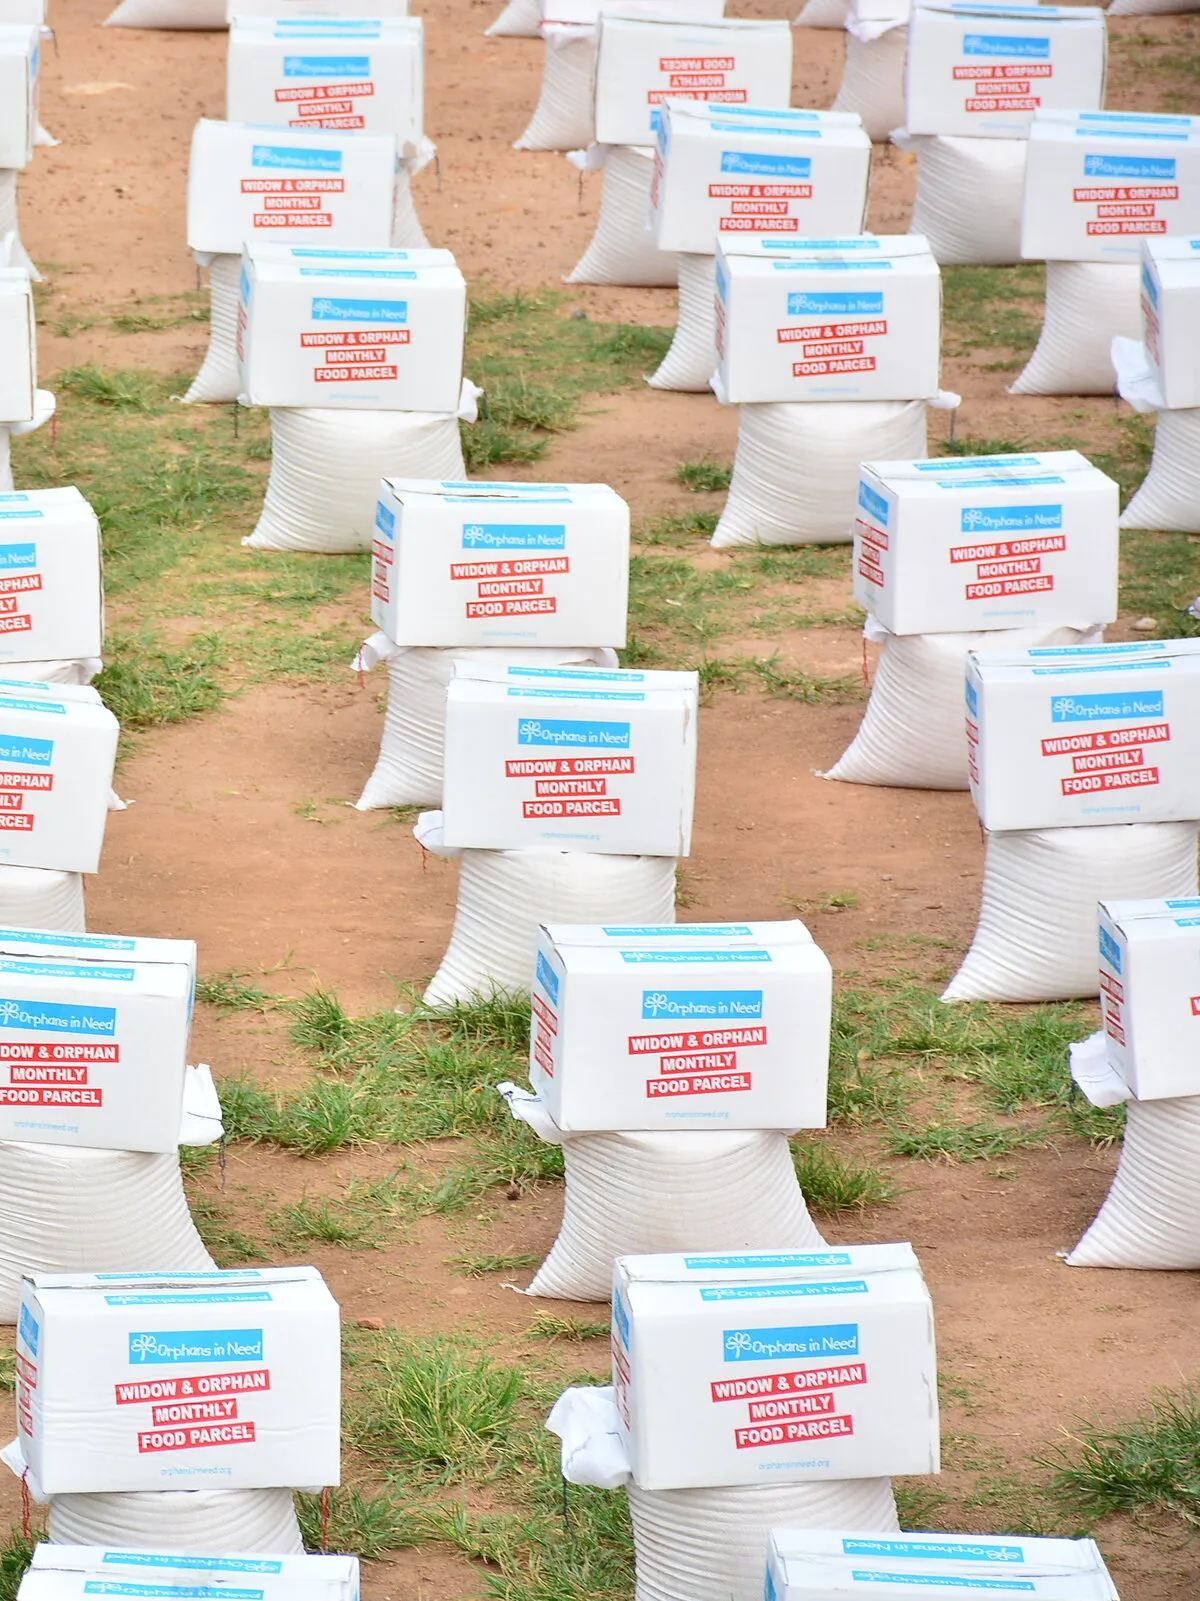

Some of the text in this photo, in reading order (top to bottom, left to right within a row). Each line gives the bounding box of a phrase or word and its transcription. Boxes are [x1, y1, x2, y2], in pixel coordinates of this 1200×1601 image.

[1075, 189, 1116, 200] WIDOW
[1129, 187, 1176, 199] ORPHAN
[779, 327, 822, 341] WIDOW
[835, 322, 885, 337] ORPHAN
[804, 341, 862, 357] MONTHLY
[794, 358, 875, 375] FOOD PARCEL
[1043, 725, 1168, 753] WIDOW & ORPHAN
[508, 758, 632, 775] WIDOW & ORPHAN
[1074, 750, 1141, 771] MONTHLY
[537, 780, 605, 795] MONTHLY
[1063, 769, 1158, 793] FOOD PARCEL
[524, 800, 619, 815] FOOD PARCEL
[667, 1001, 762, 1017] Orphans in Need
[18, 1012, 115, 1031] Orphans in Need
[631, 1028, 764, 1052] WIDOW & ORPHAN
[37, 1046, 50, 1059] &
[53, 1046, 116, 1060] ORPHAN
[662, 1053, 735, 1072] MONTHLY
[12, 1068, 86, 1082] MONTHLY
[648, 1074, 749, 1095] FOOD PARCEL
[42, 1090, 100, 1104] PARCEL
[157, 1341, 262, 1361] Orphans in Need
[751, 1336, 857, 1357] Orphans in Need
[118, 1372, 267, 1401] WIDOW & ORPHAN
[714, 1366, 863, 1399] WIDOW & ORPHAN
[154, 1401, 235, 1423] MONTHLY
[751, 1395, 832, 1419] MONTHLY
[140, 1424, 253, 1449] FOOD PARCEL
[737, 1418, 851, 1445] FOOD PARCEL
